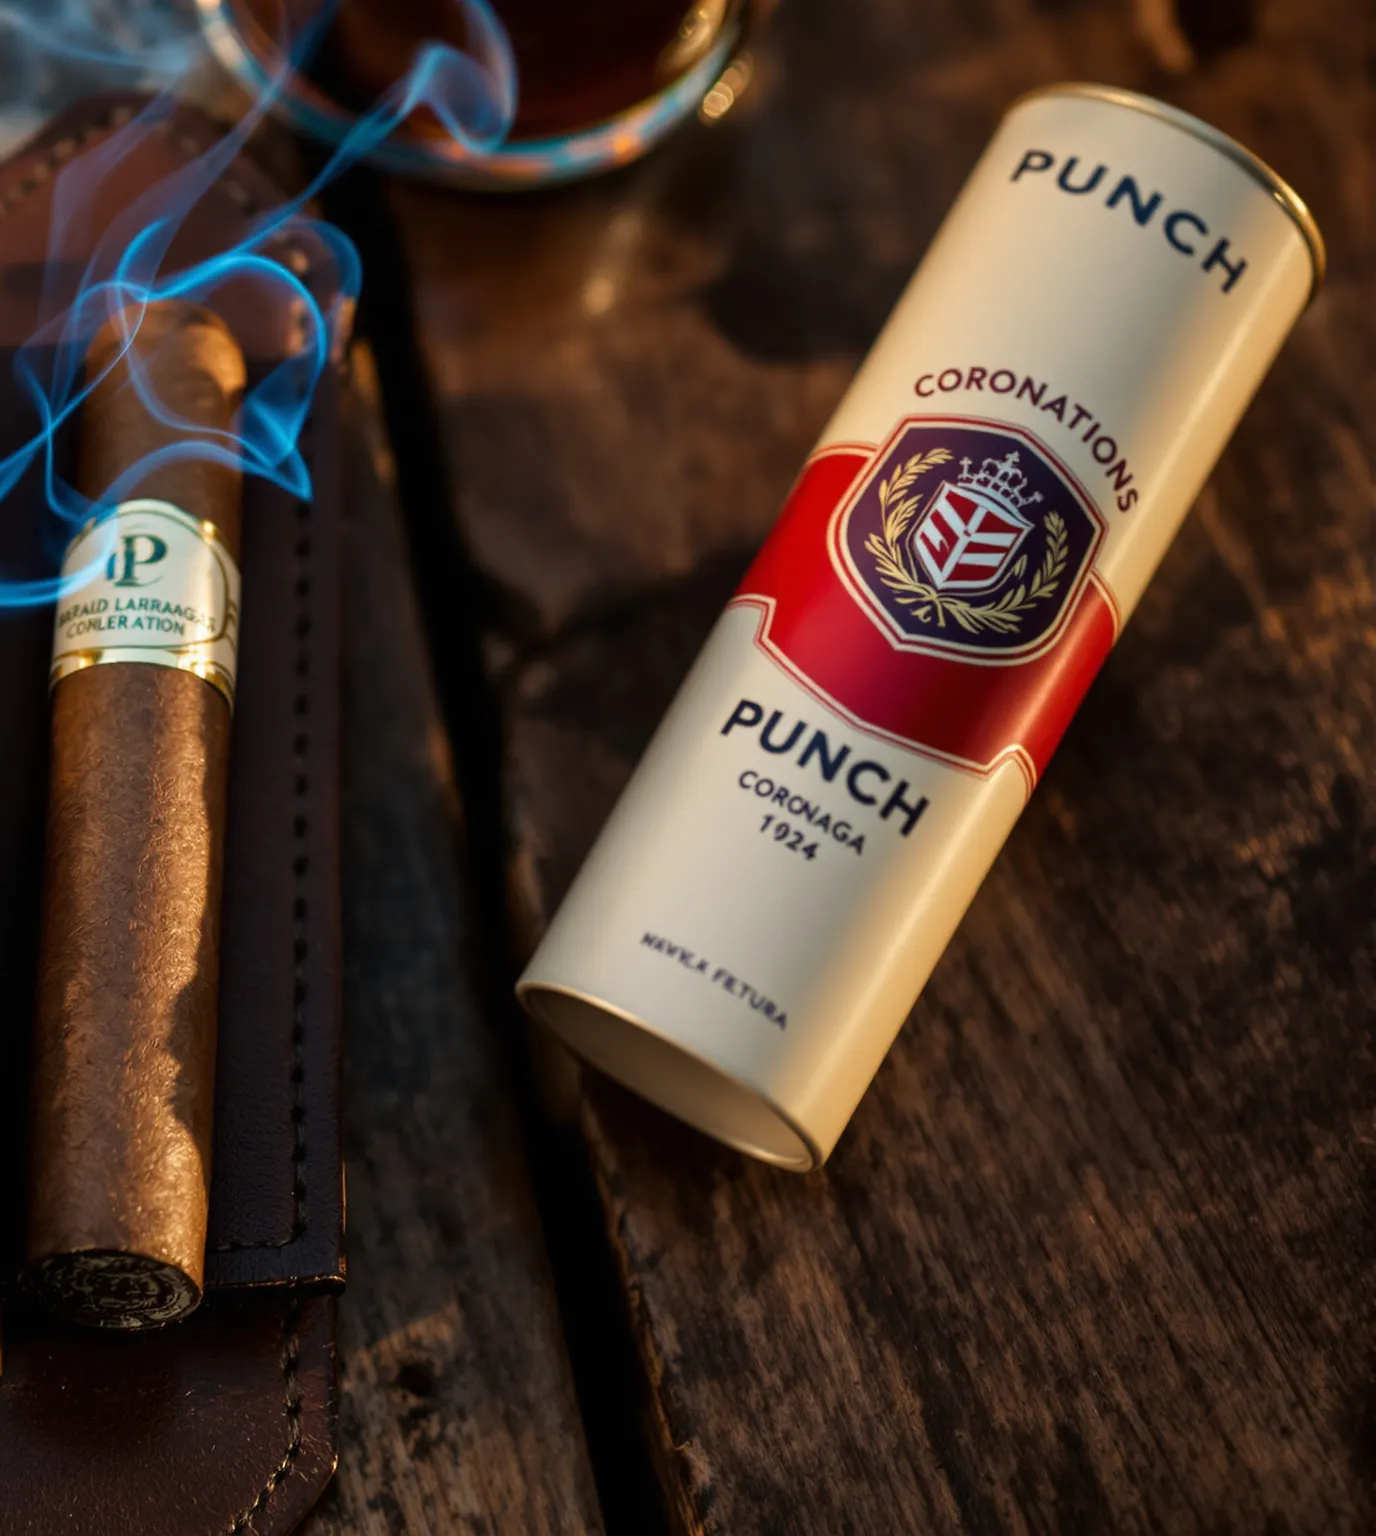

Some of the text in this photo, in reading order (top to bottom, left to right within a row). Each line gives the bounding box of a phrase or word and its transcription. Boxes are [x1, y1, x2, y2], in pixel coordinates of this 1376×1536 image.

[1010, 149, 1248, 294] PUNCH
[914, 366, 1138, 513] CORONATIONS
[720, 699, 931, 838] PUNCH
[738, 769, 867, 856] CORONAGA
